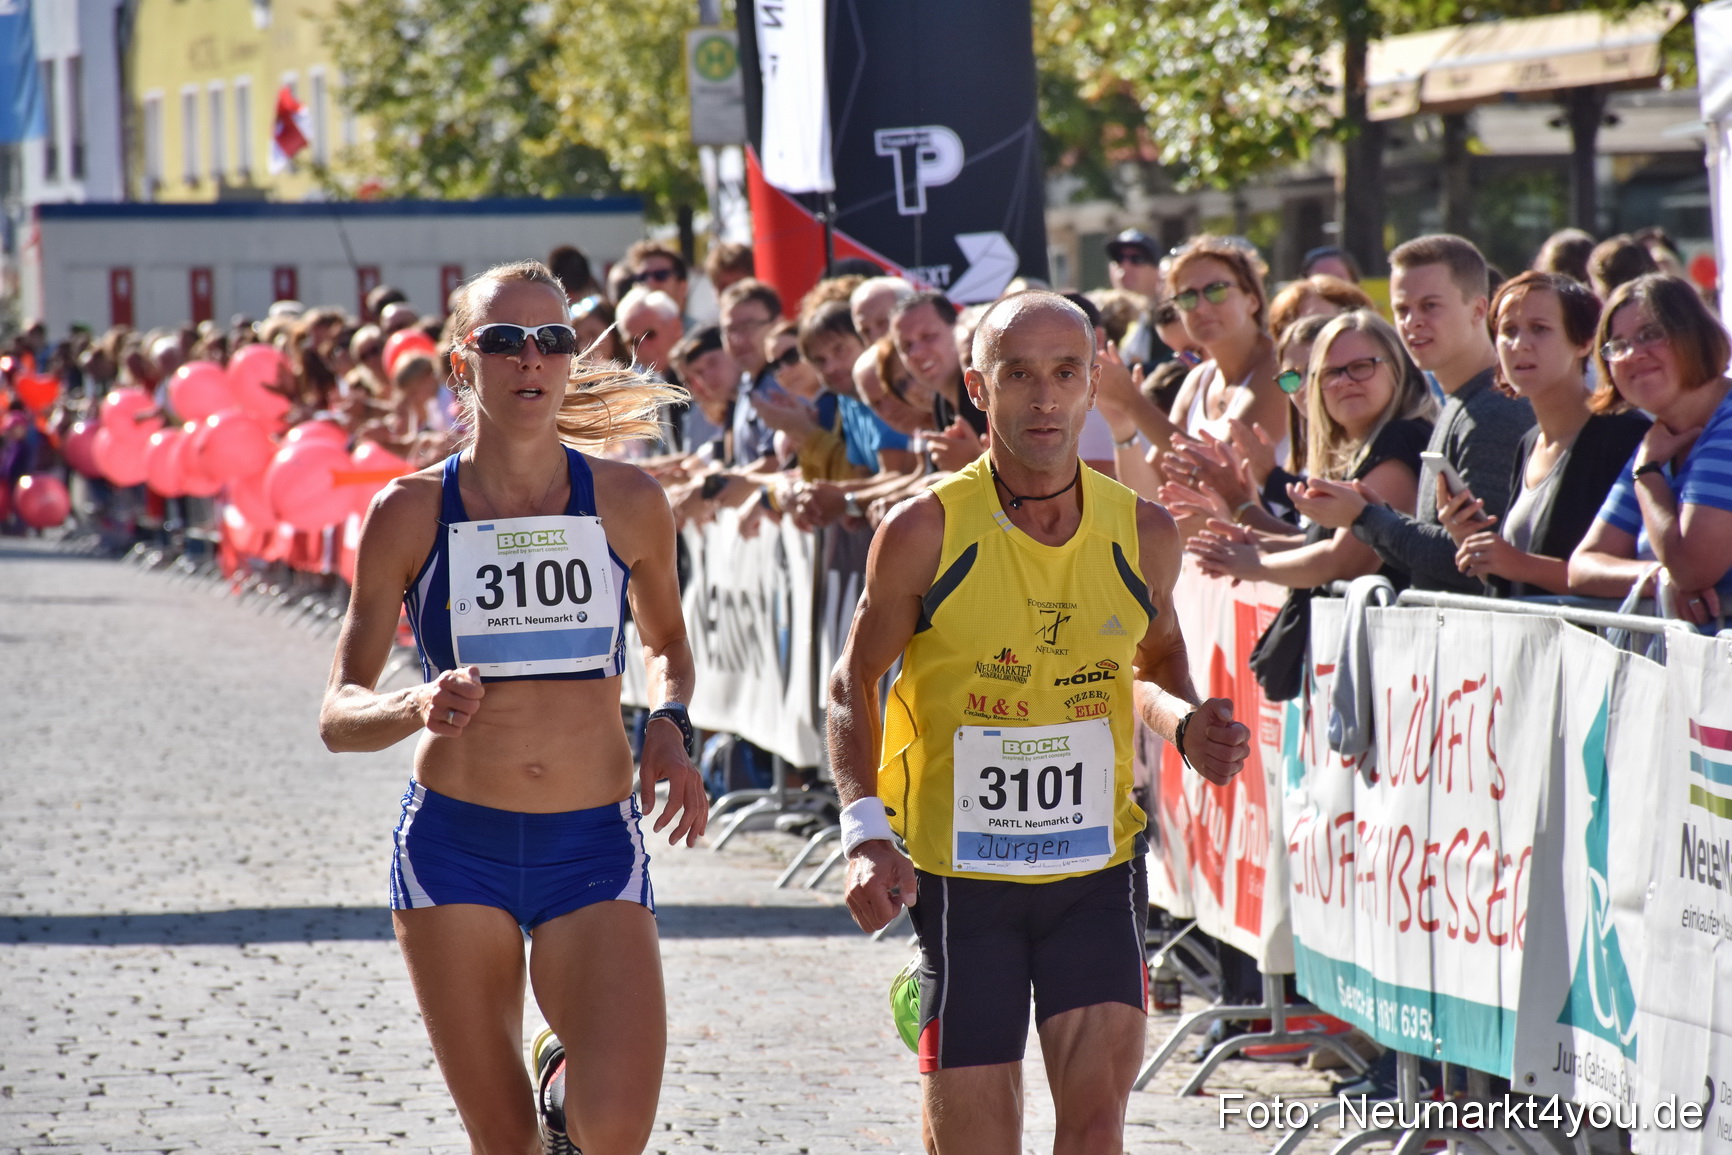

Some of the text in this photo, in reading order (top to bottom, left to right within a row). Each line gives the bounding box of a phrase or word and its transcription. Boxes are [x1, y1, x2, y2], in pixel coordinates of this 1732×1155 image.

[497, 529, 568, 549] BOCK
[475, 558, 593, 611] 3100
[459, 603, 466, 611] D
[487, 614, 574, 627] PARTL Neumarkt
[974, 661, 1032, 677] NEUMARKTER
[966, 692, 987, 712] M
[992, 698, 1010, 715] &
[1016, 700, 1029, 717] S
[1064, 690, 1111, 709] PIZZERIA
[1074, 701, 1107, 718] ELIO
[1002, 736, 1070, 755] BOCK
[978, 762, 1084, 812] 3101
[962, 799, 969, 809] D
[988, 816, 1070, 829] PARTL Neumarkt
[977, 834, 1071, 864] Jürgen
[1679, 822, 1732, 896] NeueM
[1553, 1042, 1582, 1078] Jura
